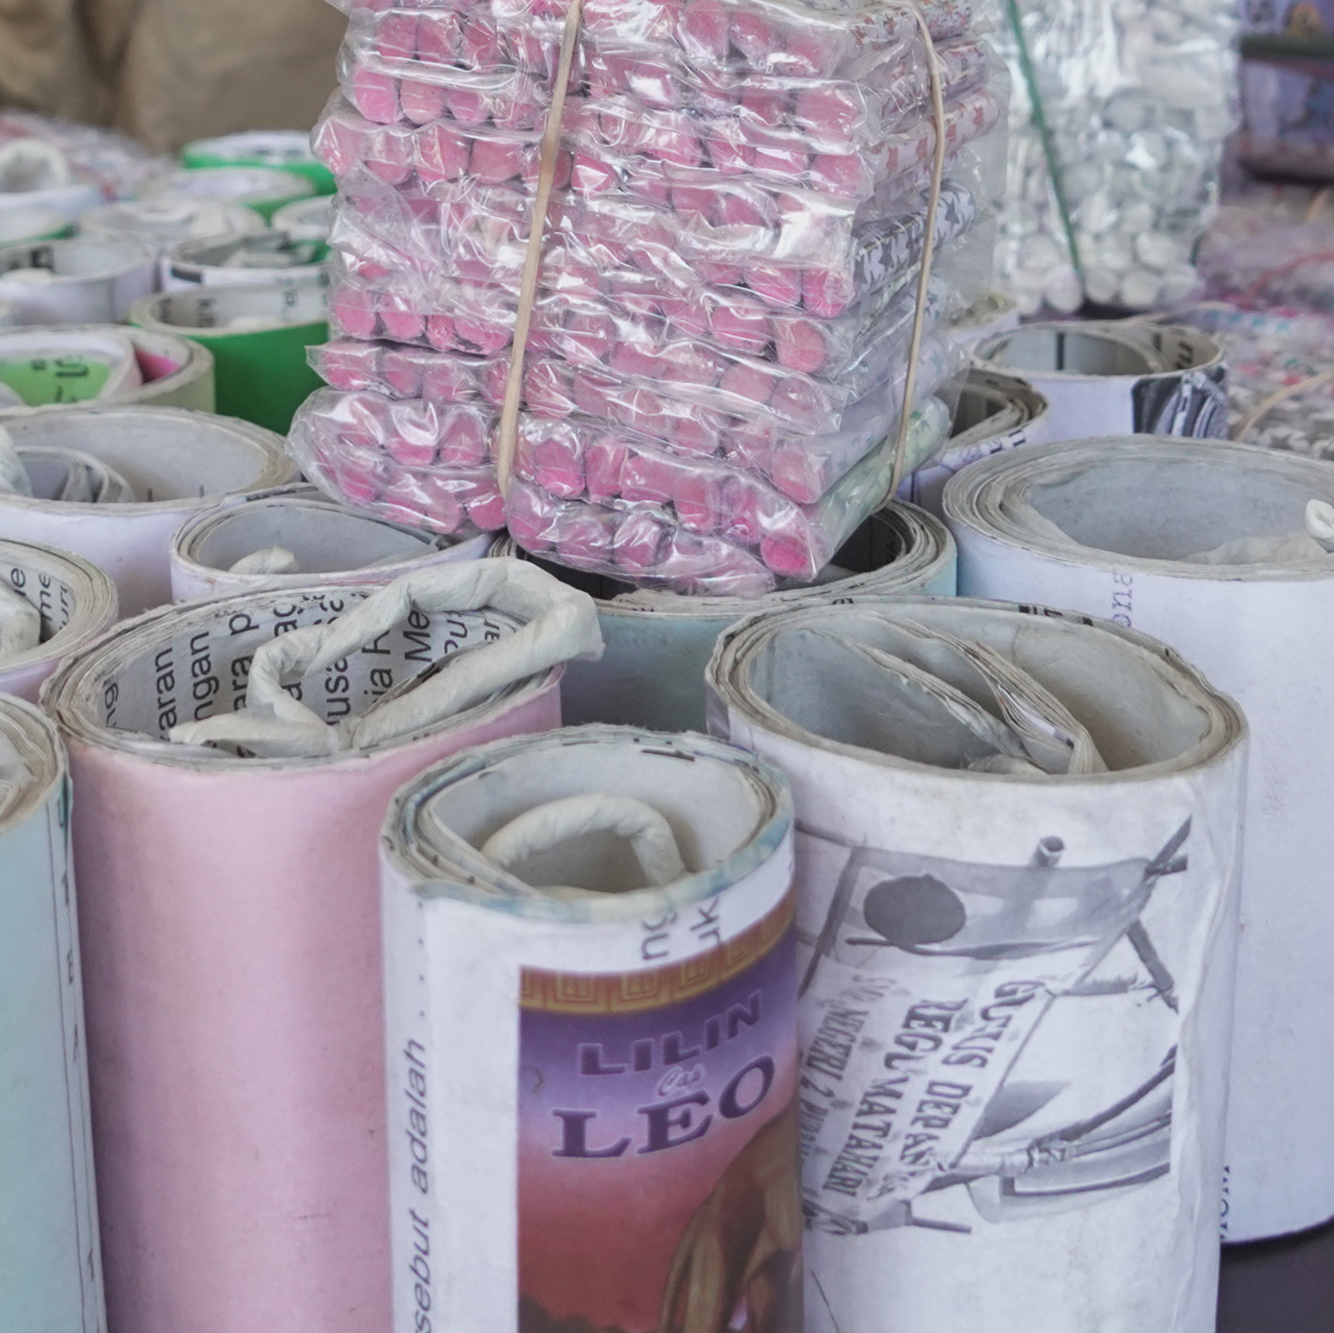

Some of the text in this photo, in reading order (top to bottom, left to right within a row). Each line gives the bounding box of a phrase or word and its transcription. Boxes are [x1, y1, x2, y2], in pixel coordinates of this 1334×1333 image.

[578, 988, 763, 1077] LILIN
[402, 1036, 430, 1195] adalah
[551, 1055, 776, 1159] LEO
[821, 1075, 910, 1198] MATAHARI
